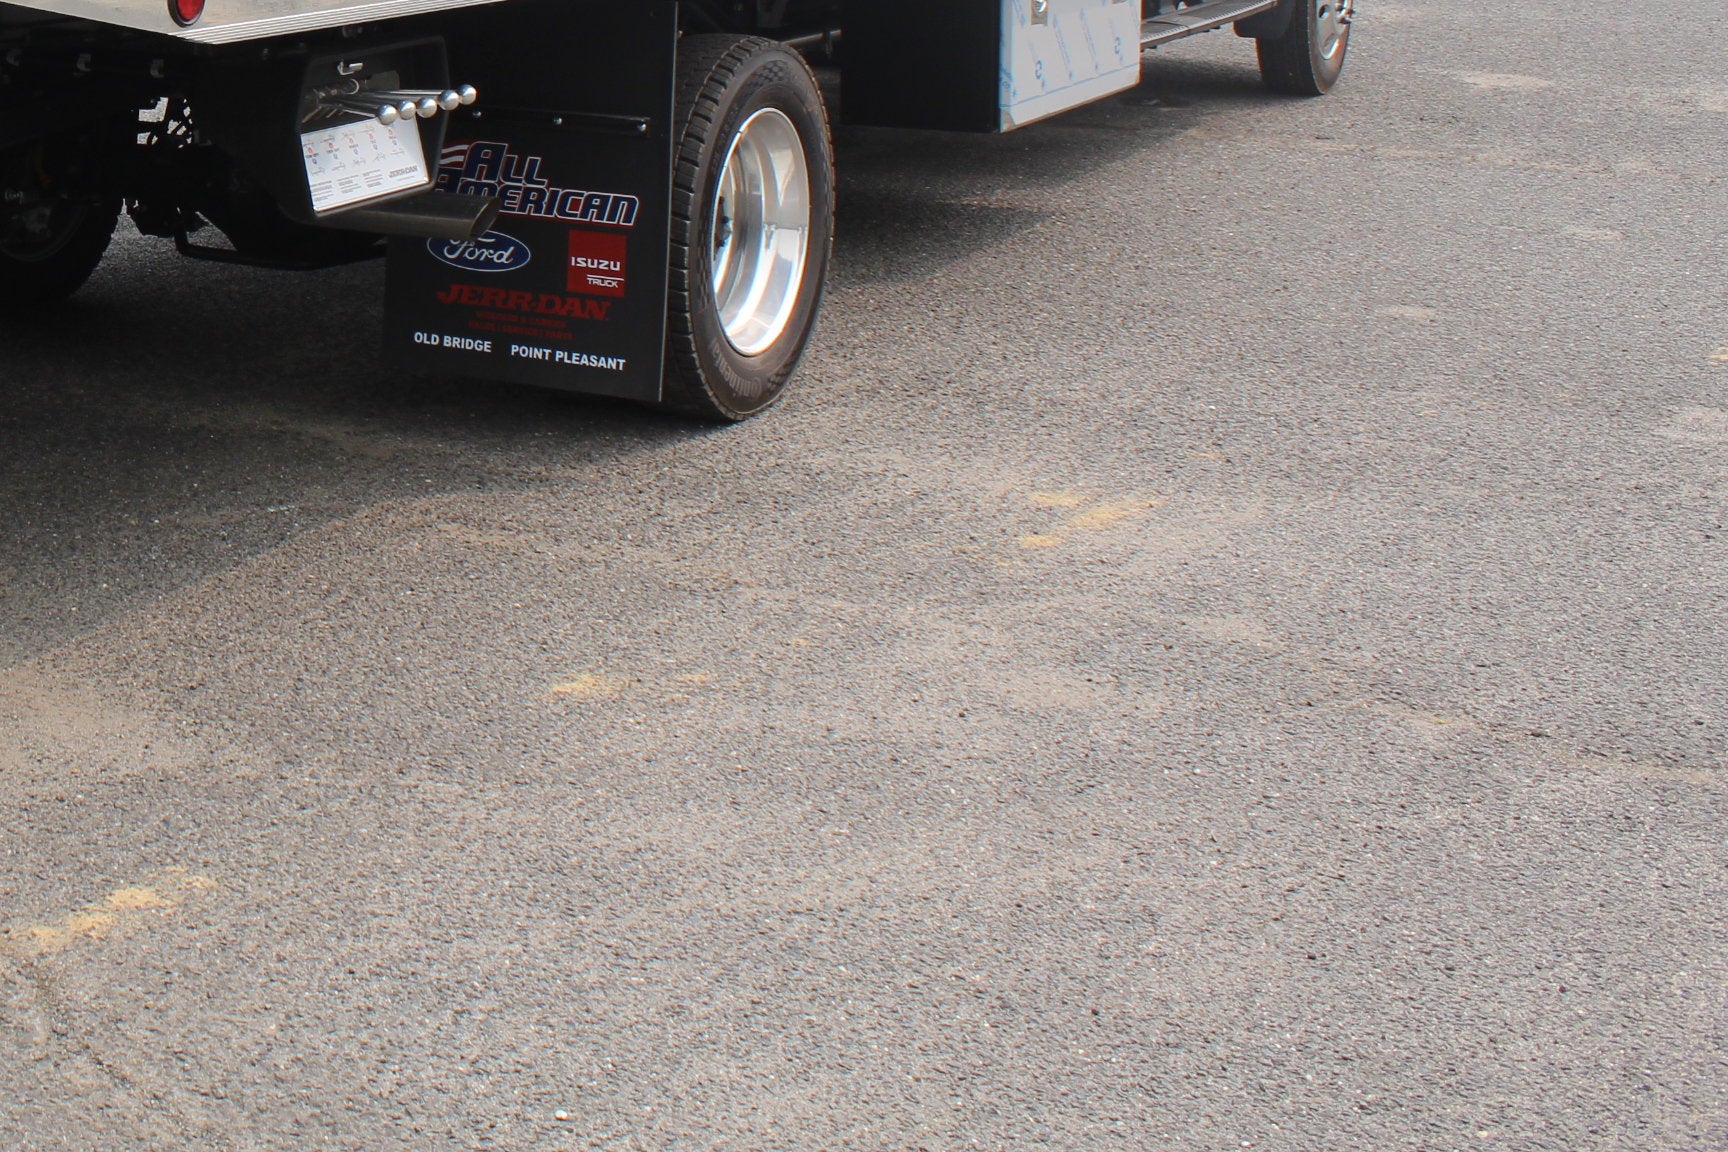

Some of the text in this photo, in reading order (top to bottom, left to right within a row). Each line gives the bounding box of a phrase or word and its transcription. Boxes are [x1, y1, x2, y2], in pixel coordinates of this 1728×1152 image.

[463, 140, 548, 188] ALL
[570, 256, 621, 271] ISUZU
[587, 277, 619, 288] TRUCK
[414, 331, 627, 371] OLD BRIDGE POINT PLEASANT
